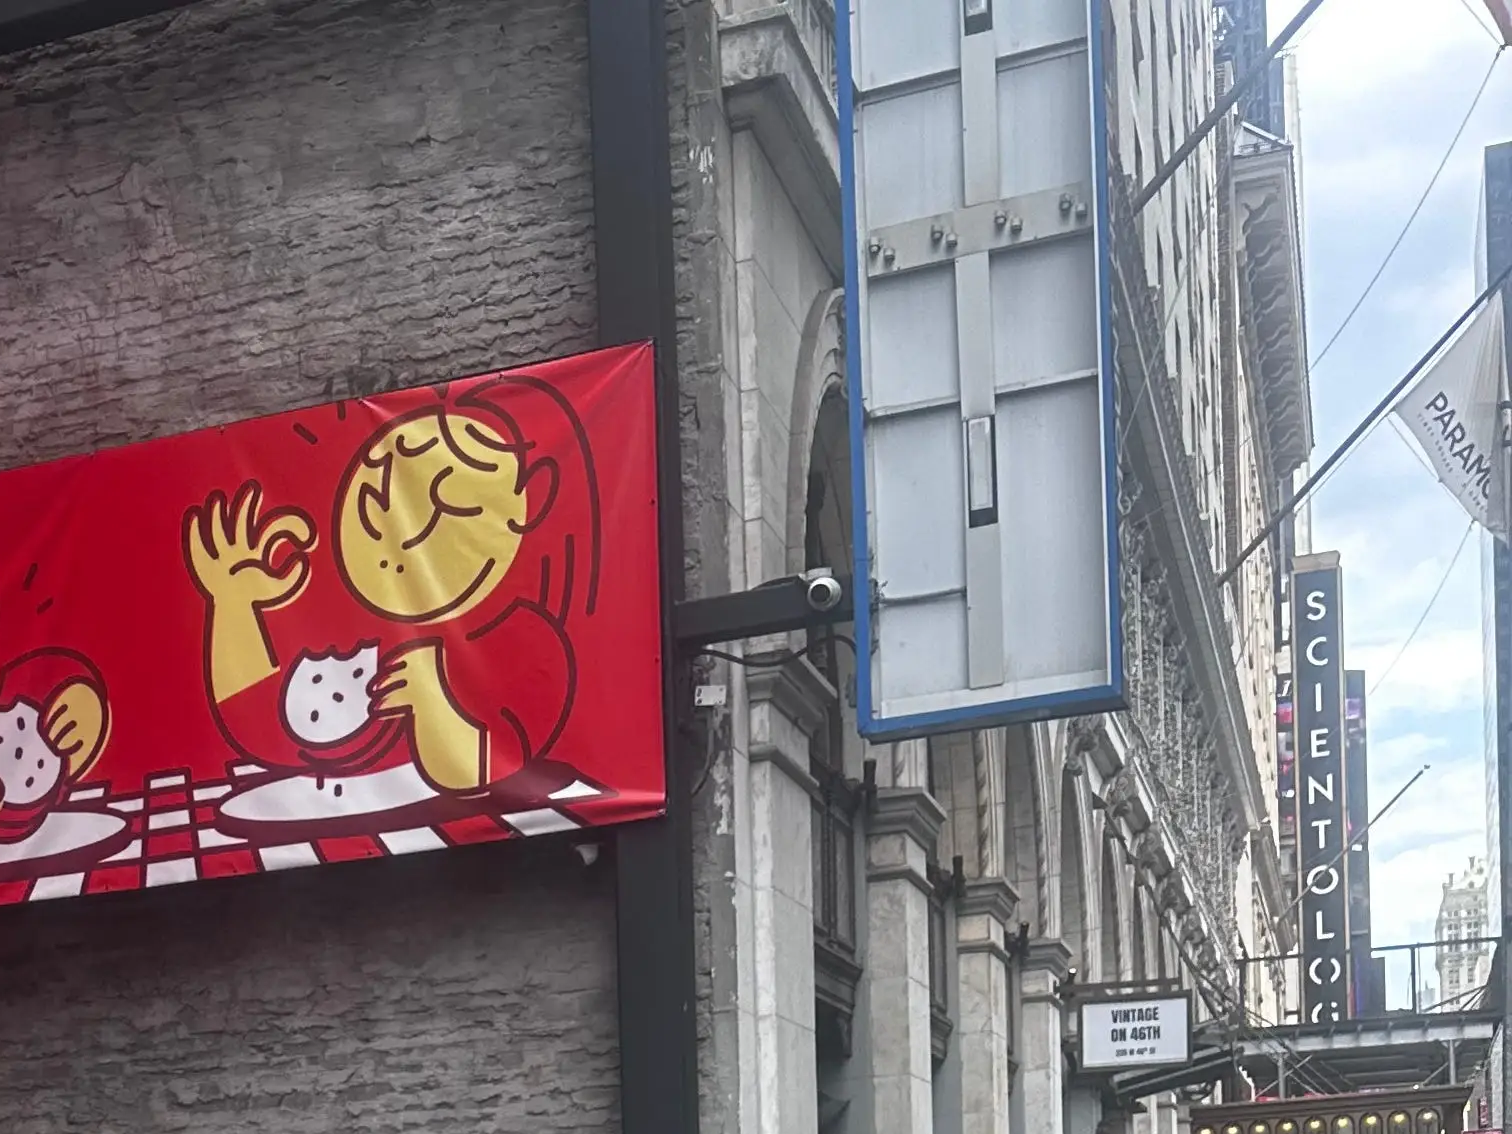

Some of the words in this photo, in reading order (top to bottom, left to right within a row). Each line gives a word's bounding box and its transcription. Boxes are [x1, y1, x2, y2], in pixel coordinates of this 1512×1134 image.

[1111, 1006, 1159, 1024] VINTAGE
[1111, 1028, 1127, 1042] ON
[1130, 1026, 1161, 1041] 46TH
